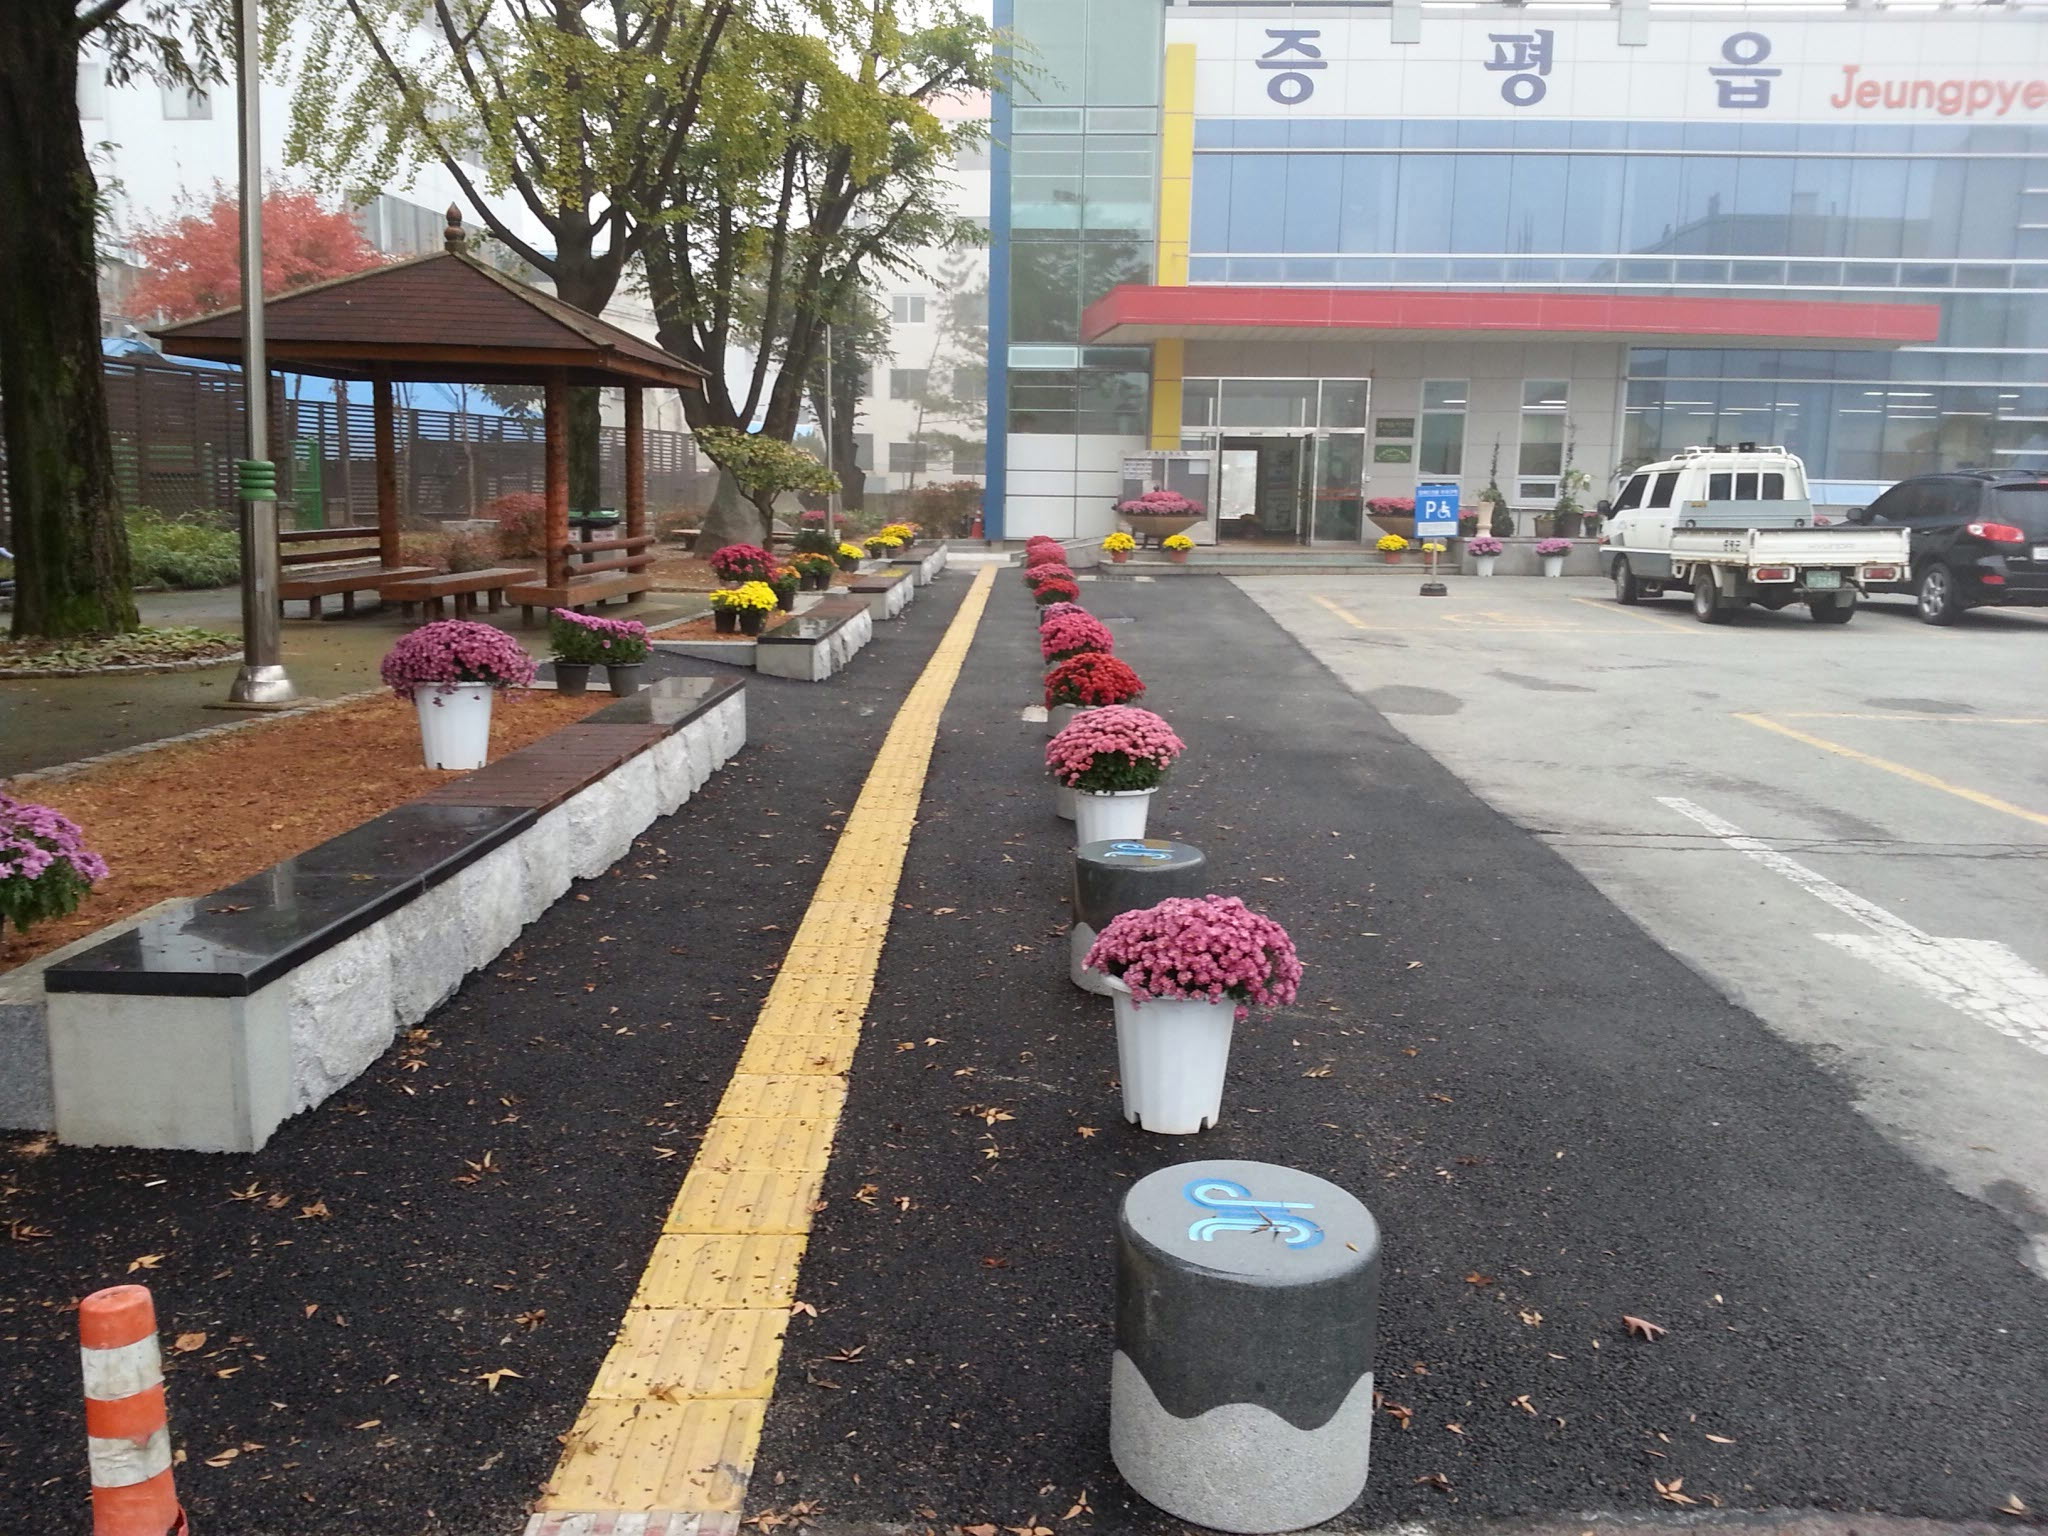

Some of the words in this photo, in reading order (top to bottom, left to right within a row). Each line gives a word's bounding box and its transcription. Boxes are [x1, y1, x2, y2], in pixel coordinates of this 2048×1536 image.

[1255, 28, 1329, 106] 증
[1483, 28, 1554, 107] 평
[1708, 31, 1783, 109] 읍
[1829, 64, 2048, 117] Jeungpye
[1425, 500, 1437, 519] P
